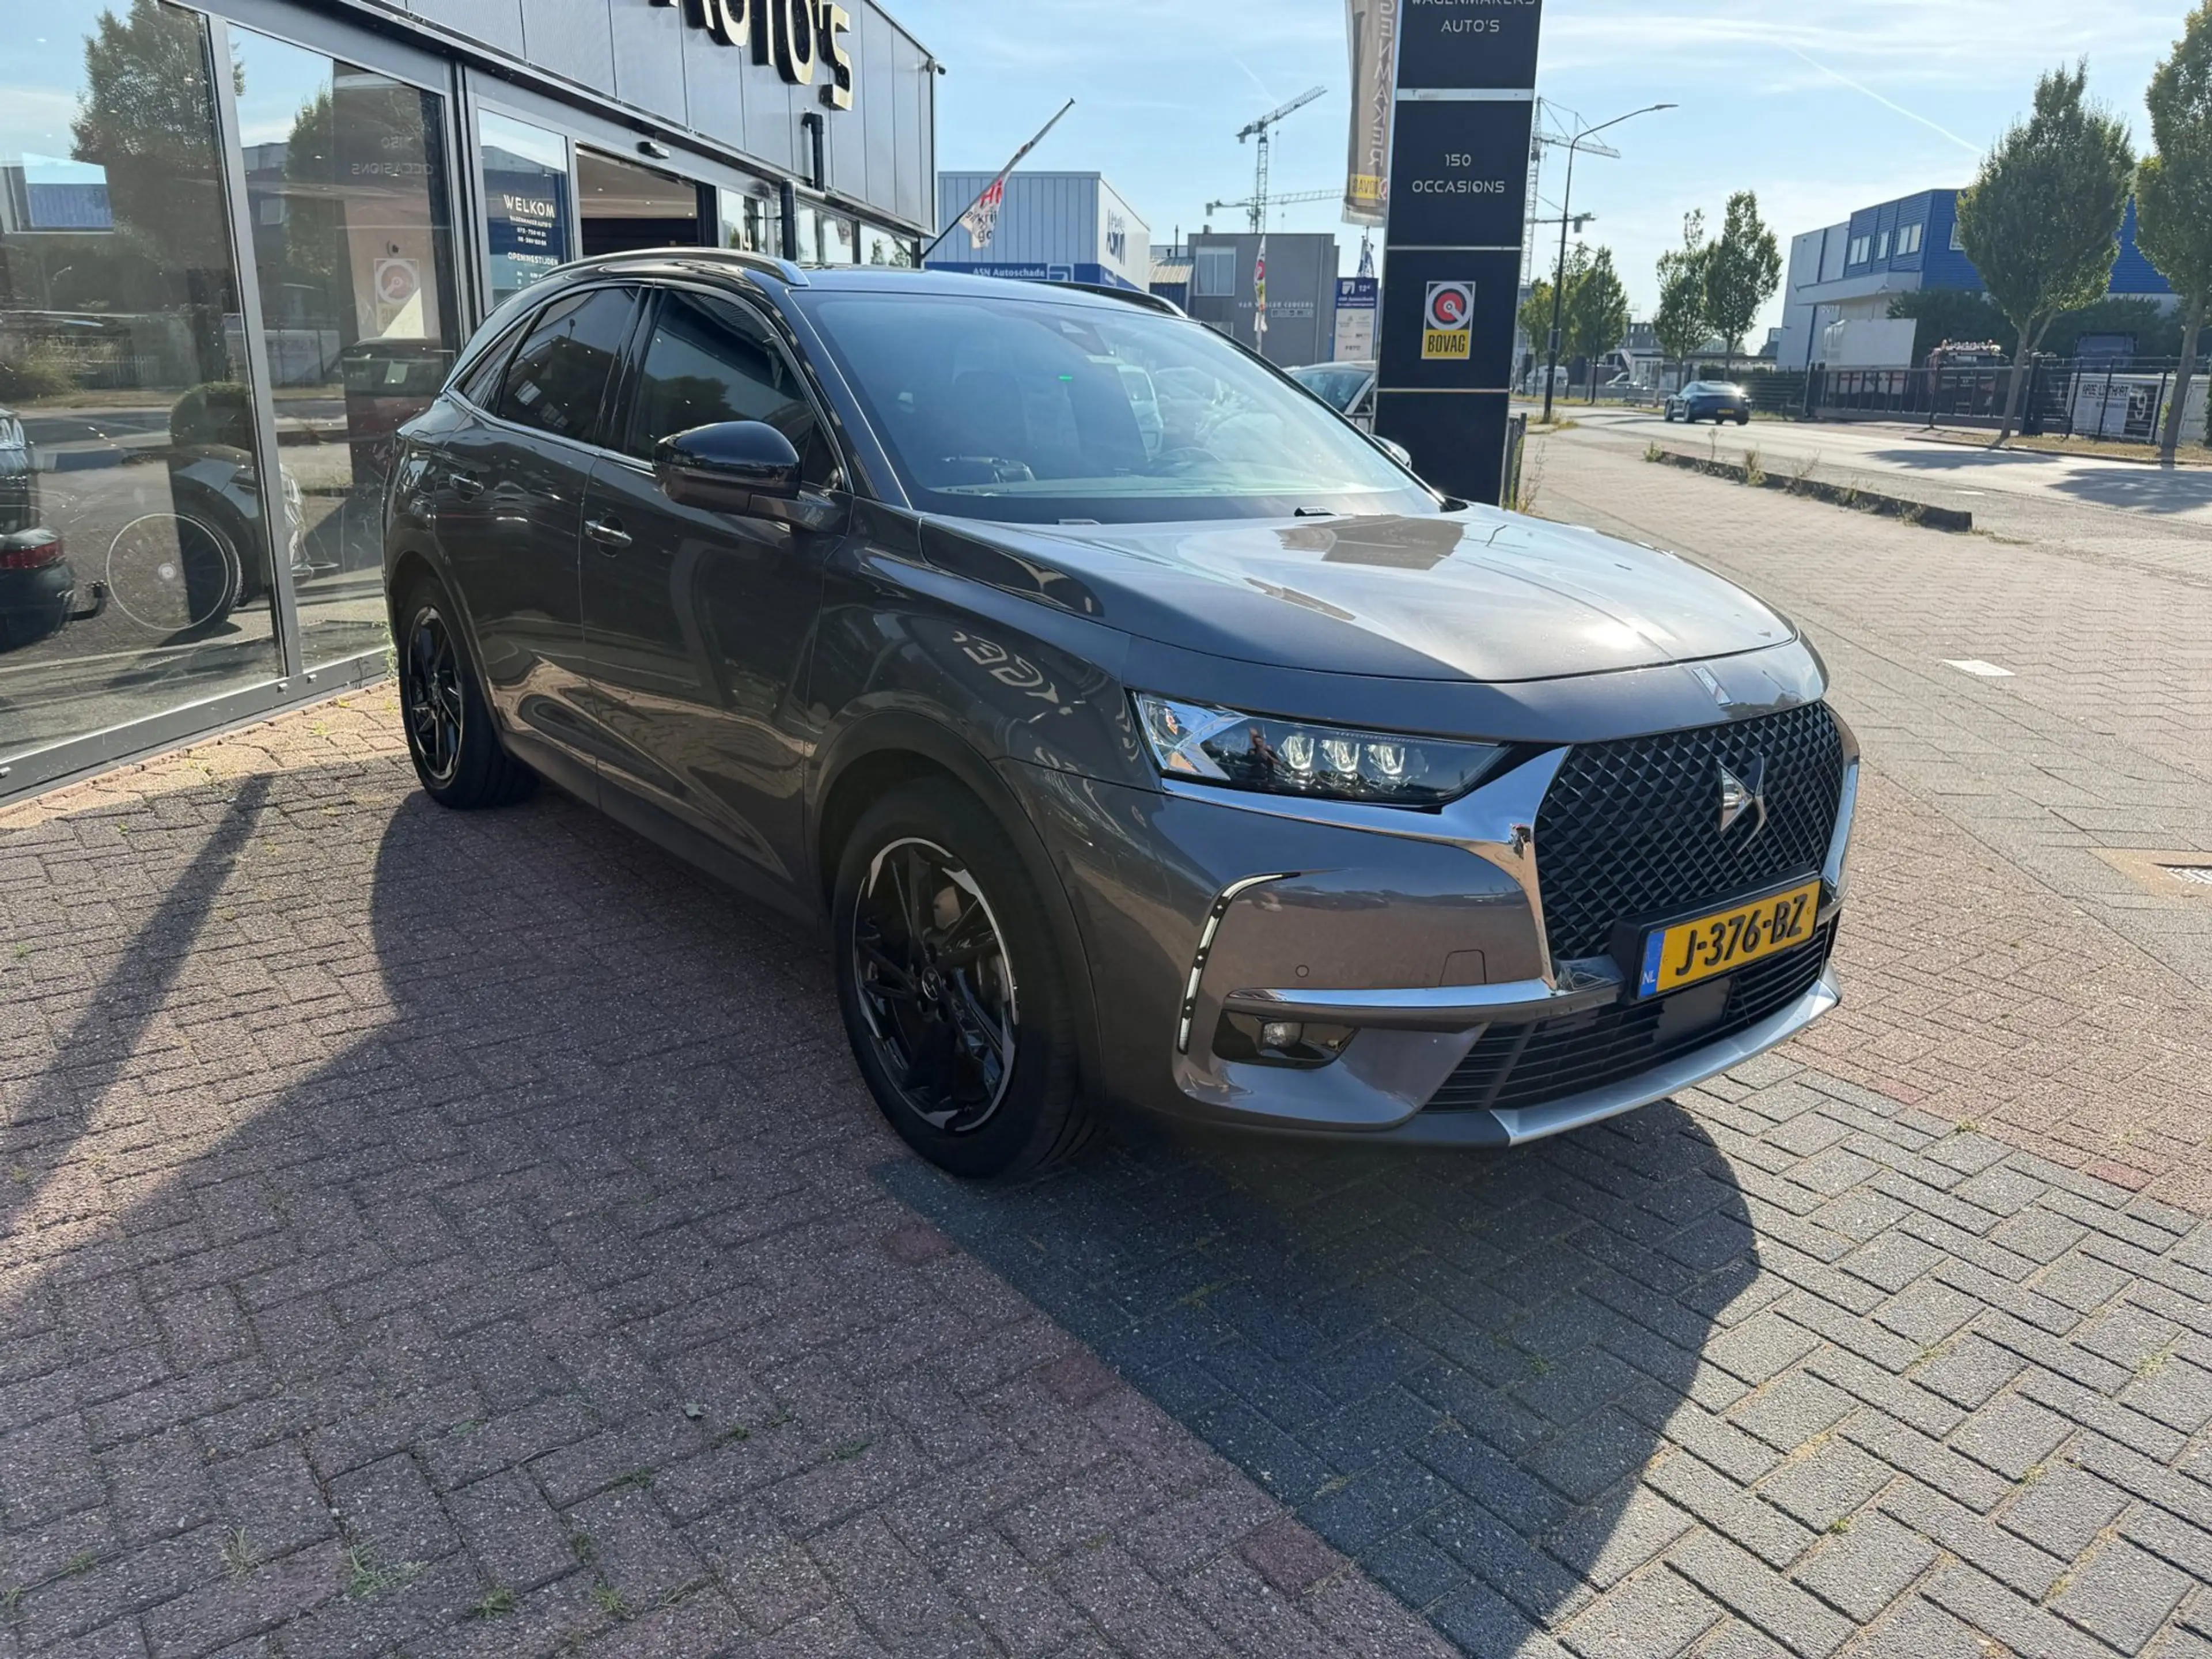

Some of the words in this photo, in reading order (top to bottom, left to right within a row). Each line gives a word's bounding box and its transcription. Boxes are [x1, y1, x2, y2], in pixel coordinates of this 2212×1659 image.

[1441, 19, 1500, 33] AUTO'S
[1445, 153, 1472, 167] 150
[1411, 180, 1505, 194] OCCASIONS
[503, 194, 555, 219] WELKOM
[507, 252, 559, 266] OPENINGSTIJDEN
[972, 267, 990, 276] ASN
[993, 267, 1045, 278] Autoschade
[1427, 334, 1465, 353] BOVAG
[1676, 893, 1809, 976] J-376-BZ
[1642, 970, 1656, 984] NL
